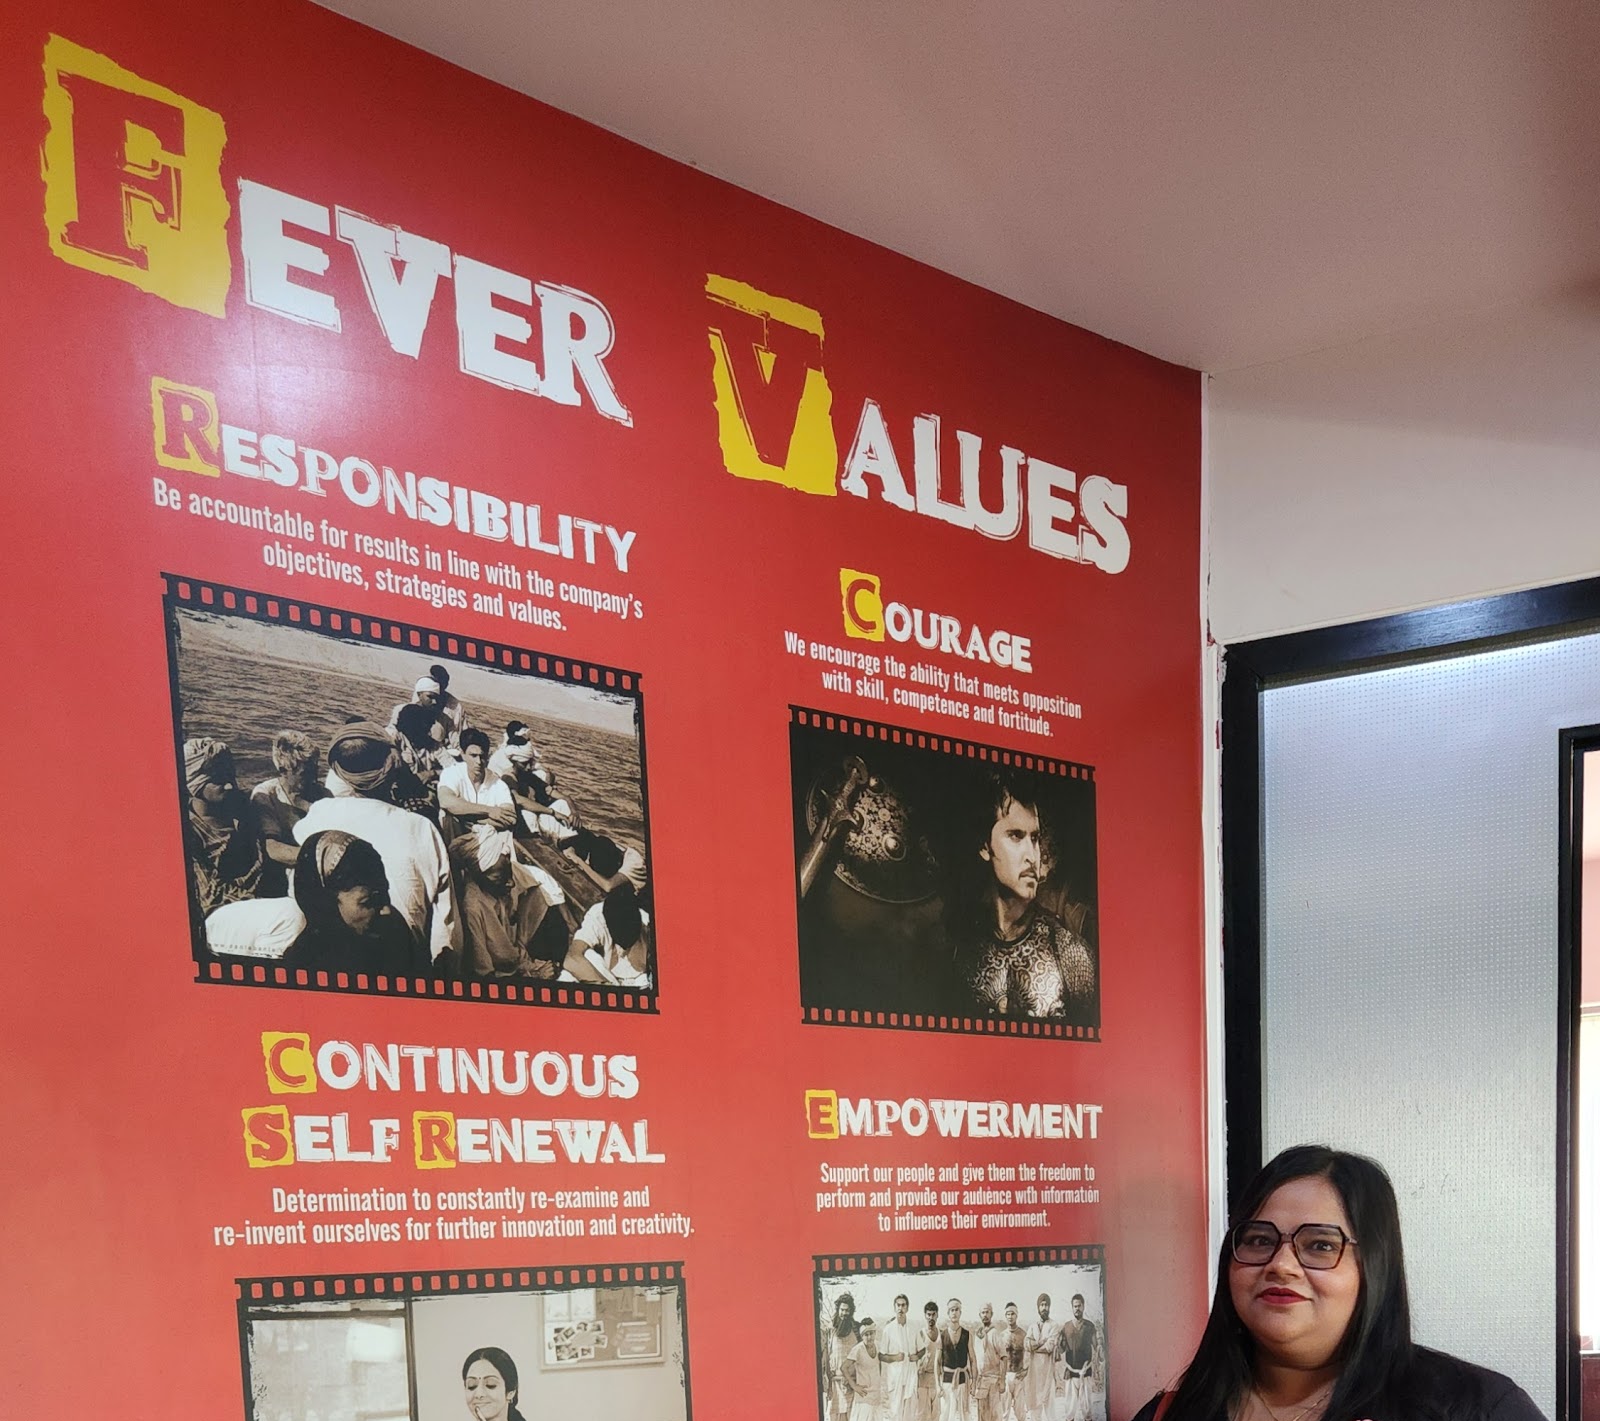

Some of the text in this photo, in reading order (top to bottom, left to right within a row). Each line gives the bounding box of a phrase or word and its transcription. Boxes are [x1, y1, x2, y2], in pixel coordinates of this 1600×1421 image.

[43, 38, 1130, 574] FEVER VALUES
[150, 376, 636, 573] RESPONSIBILITY
[153, 477, 643, 619] Be accountable for results in line with the company's
[263, 541, 567, 631] objectives, strategies and values.
[839, 567, 1032, 673] COURAGE
[784, 630, 1081, 719] We encourage the ability that meets opposition
[822, 669, 1053, 737] with skill, competence and fortitude.
[261, 1031, 640, 1099] CONTINUOUS
[241, 1105, 665, 1169] SELF RENEWAL
[805, 1089, 1103, 1139] EMPOWERMENT
[272, 1186, 650, 1214] Determination to constantly re-examine and
[816, 1186, 1100, 1212] perform and provide our audience with information
[820, 1162, 1095, 1186] Support our people and give them the freedom to
[214, 1214, 695, 1246] re-invent ourselves for further innovation and creativity.
[878, 1210, 1051, 1232] to influence their environment.
